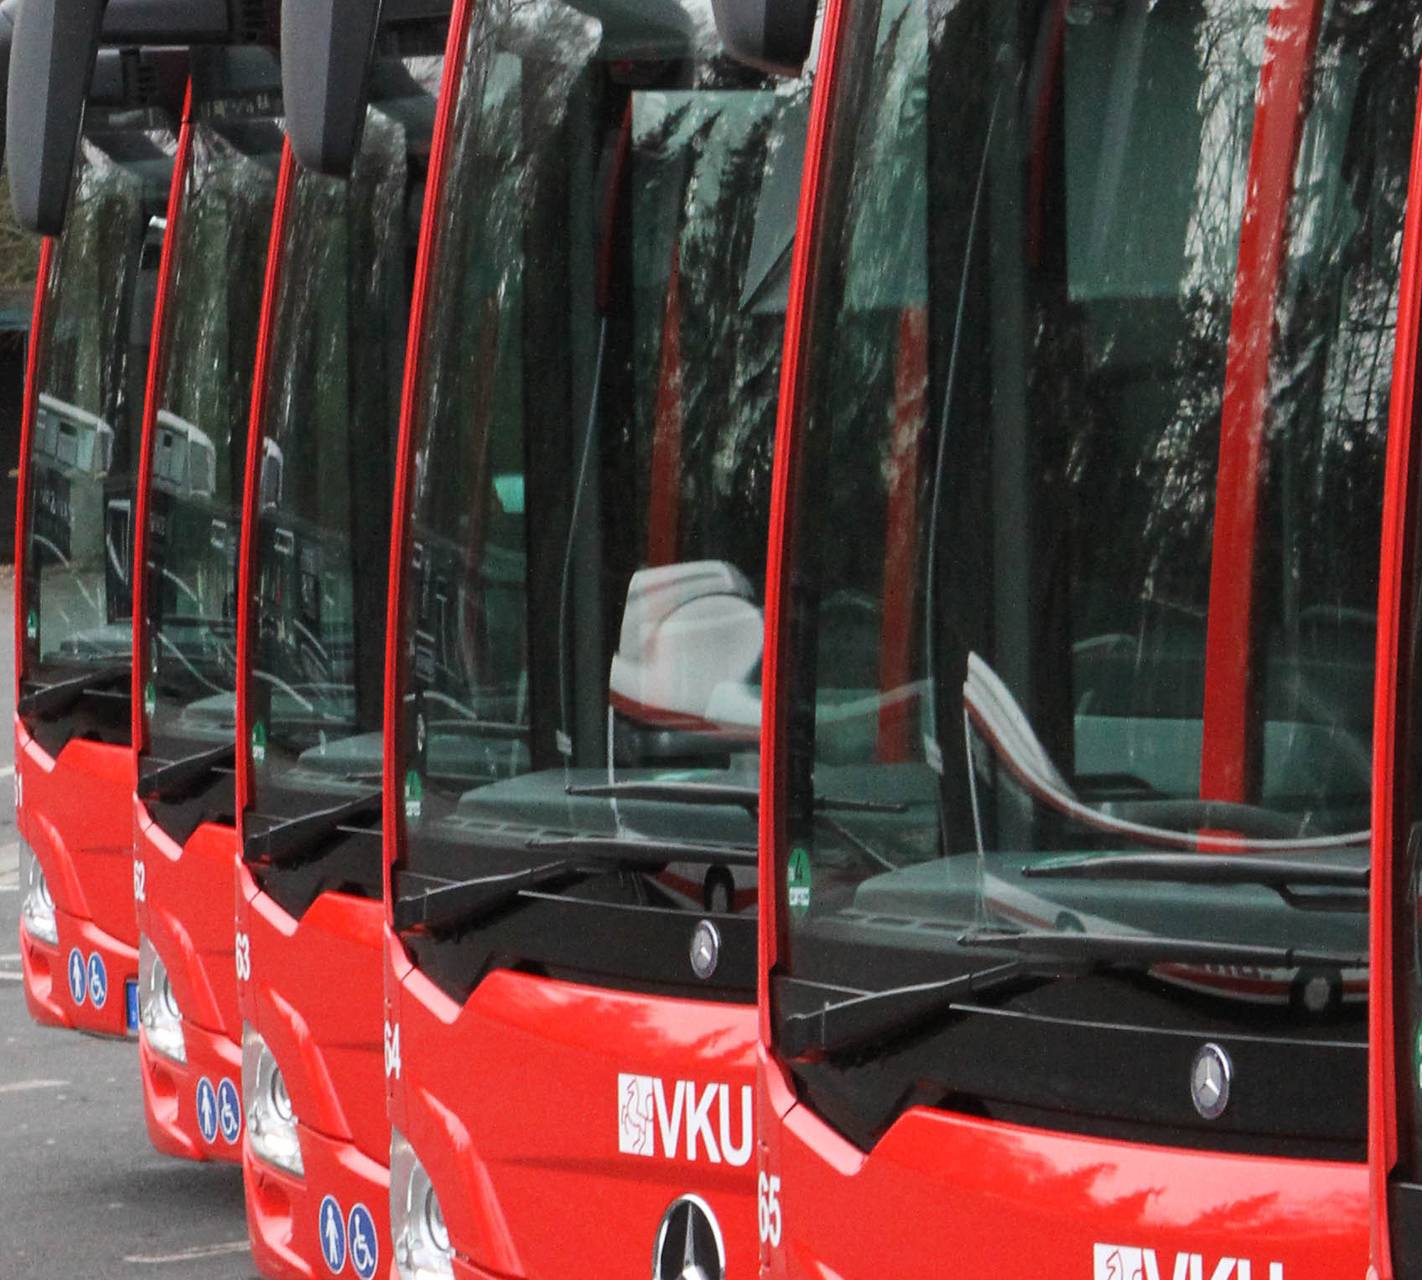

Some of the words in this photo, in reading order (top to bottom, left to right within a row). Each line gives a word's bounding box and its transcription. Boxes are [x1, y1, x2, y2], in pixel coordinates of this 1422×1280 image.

[134, 860, 145, 902] 62
[235, 932, 250, 981] 63
[384, 1020, 401, 1080] 64
[653, 1078, 753, 1167] VKU
[758, 1171, 781, 1248] 65
